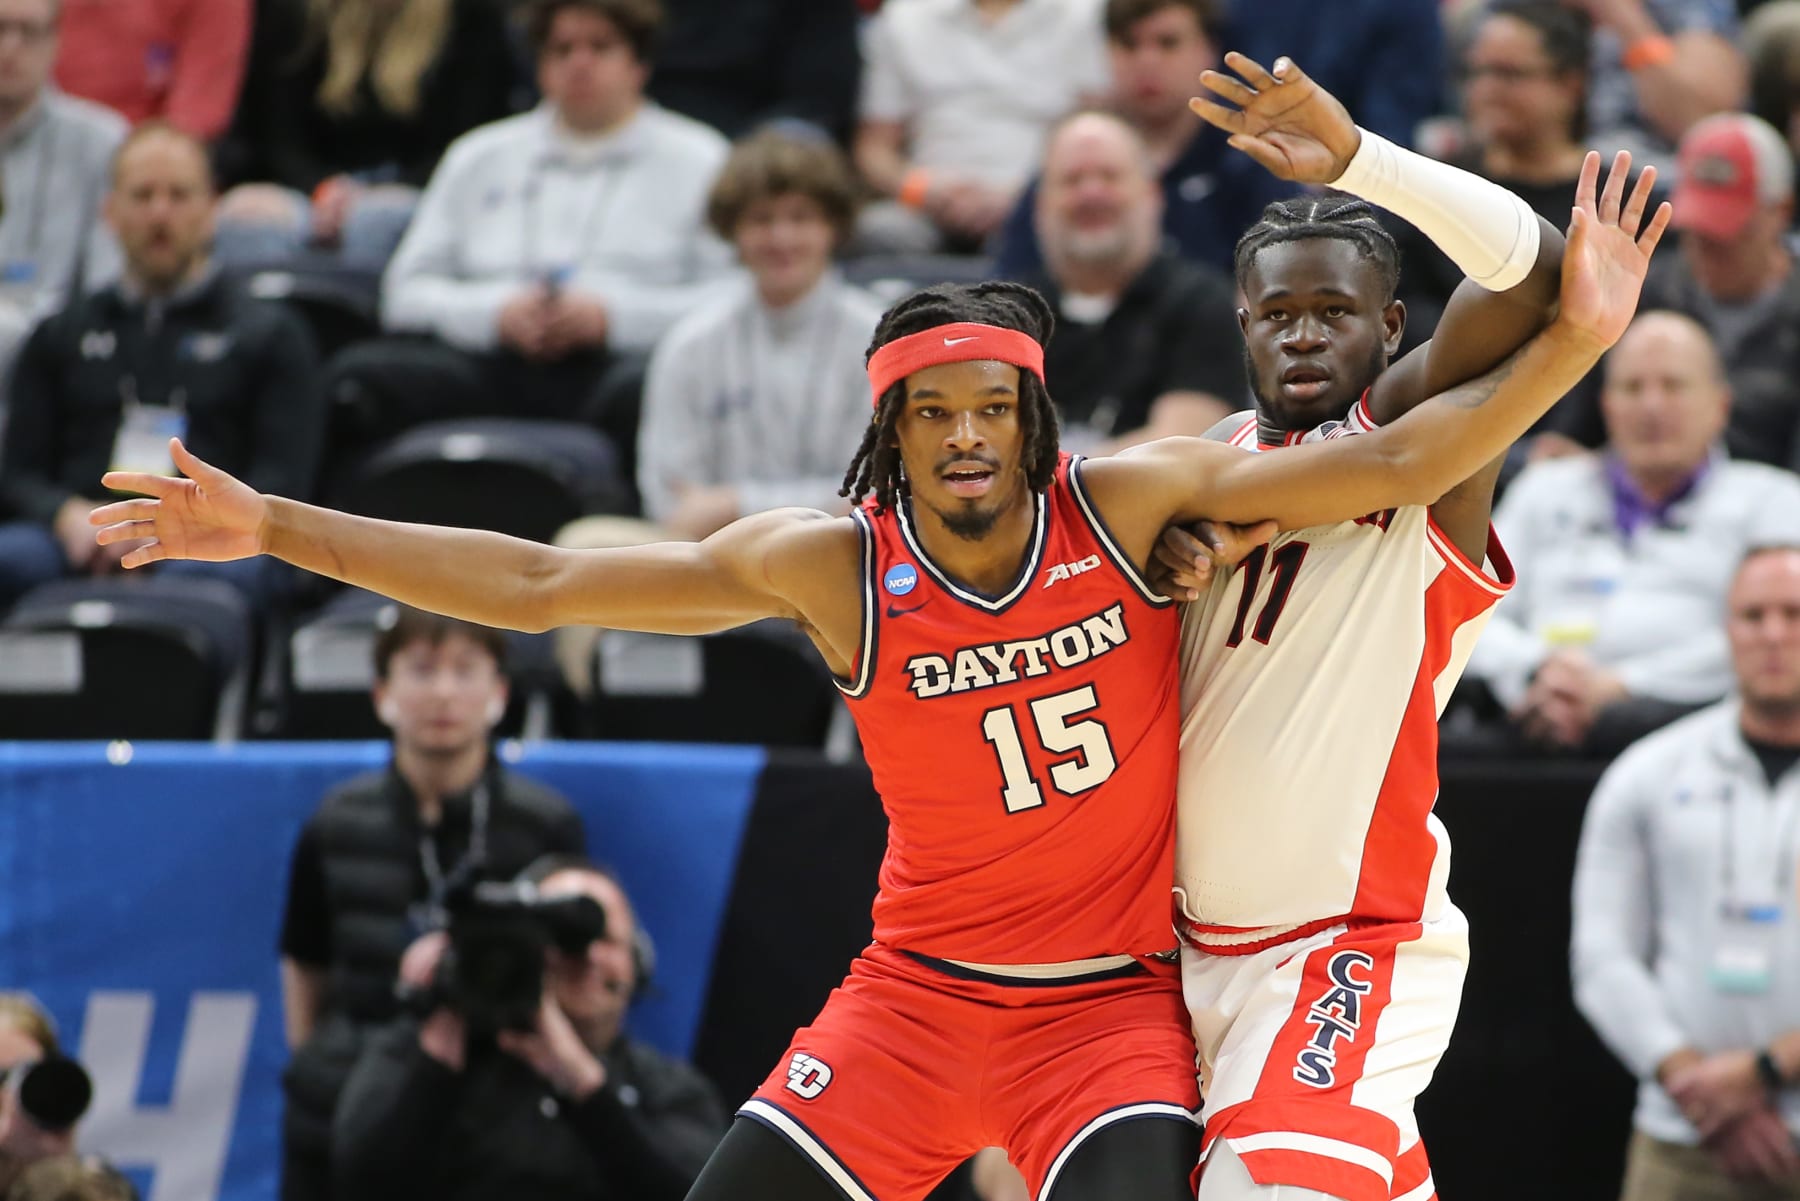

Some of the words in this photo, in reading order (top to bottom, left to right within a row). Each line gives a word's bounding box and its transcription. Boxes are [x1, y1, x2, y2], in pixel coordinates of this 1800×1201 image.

[888, 575, 915, 589] NCAA
[1042, 554, 1101, 589] A10
[1226, 541, 1310, 649] 11
[907, 601, 1129, 699] DAYTON
[980, 682, 1118, 814] 15
[1293, 950, 1374, 1089] CATS
